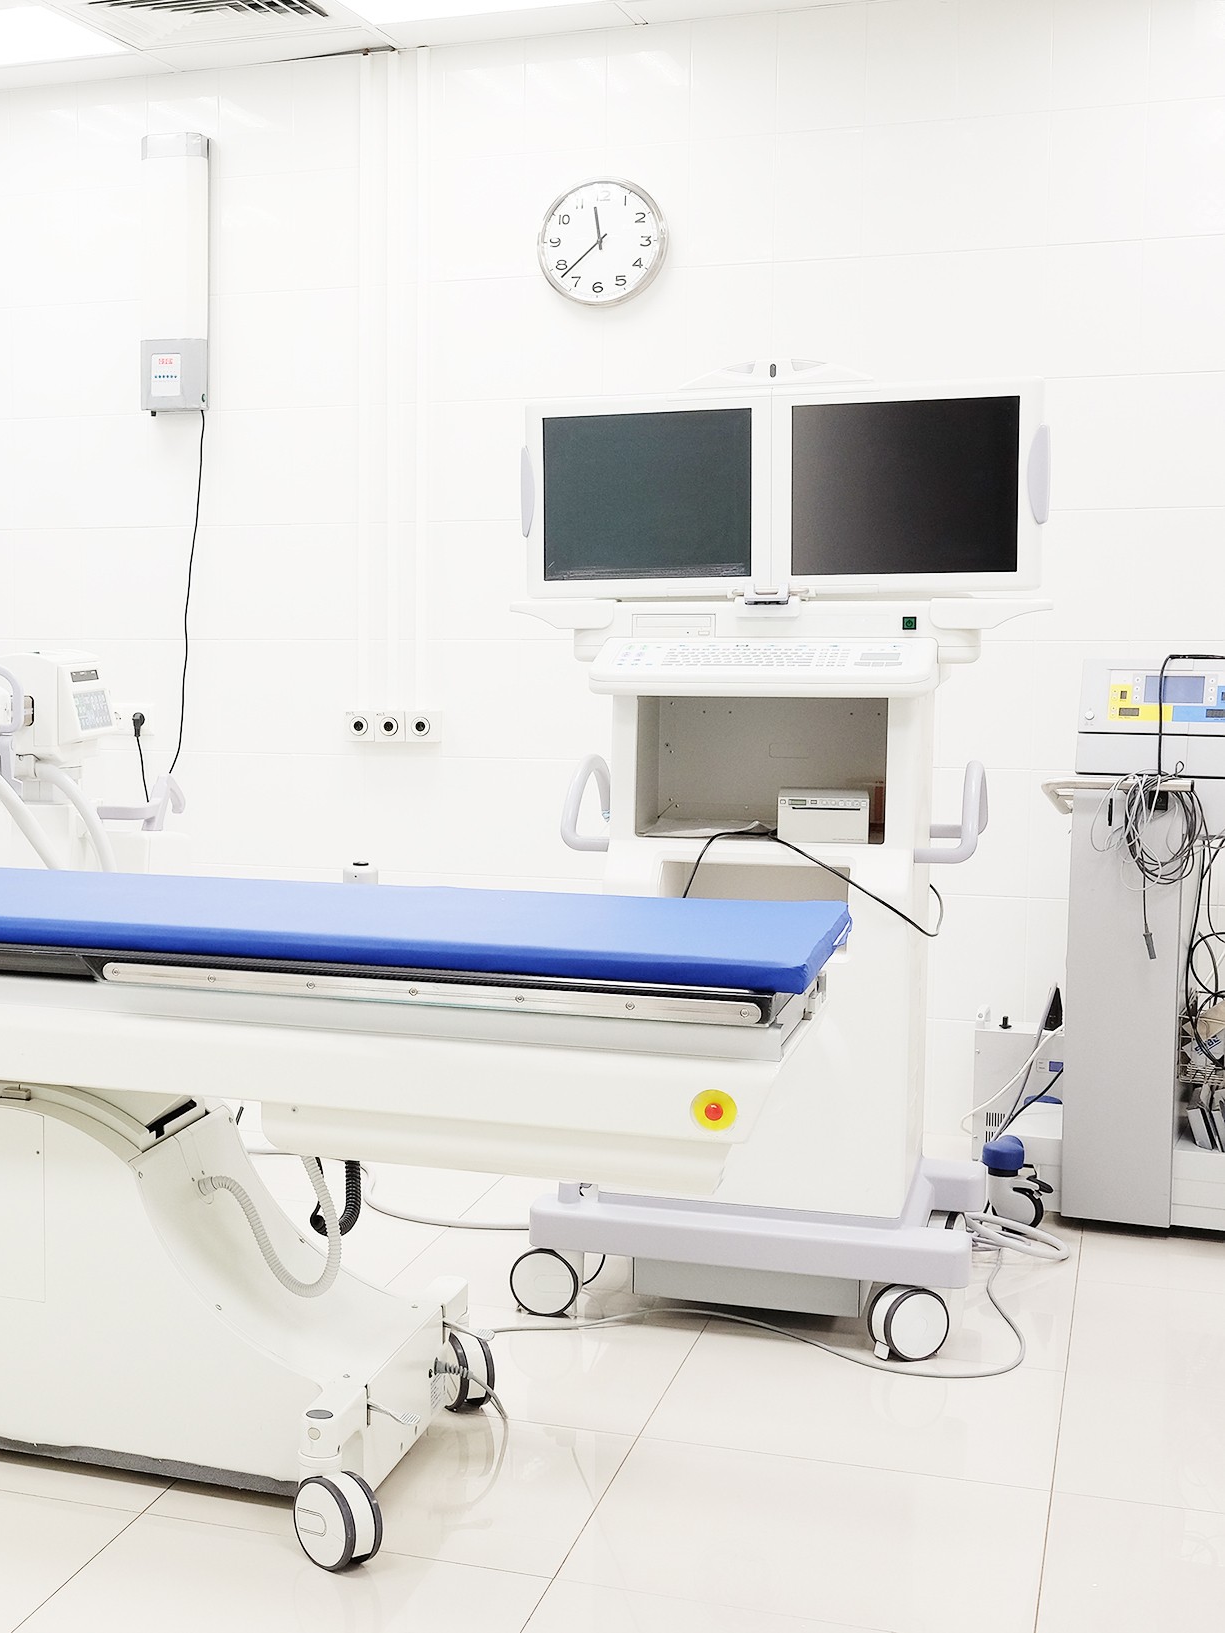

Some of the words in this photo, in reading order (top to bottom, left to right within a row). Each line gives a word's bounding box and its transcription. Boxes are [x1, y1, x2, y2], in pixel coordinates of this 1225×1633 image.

[596, 190, 611, 202] 12
[623, 195, 627, 206] 1
[558, 214, 571, 225] 10
[634, 212, 646, 223] 2
[549, 237, 562, 248] 9
[639, 235, 652, 247] 3
[555, 259, 568, 271] 8
[631, 257, 644, 269] 4
[571, 276, 582, 288] 7
[591, 281, 604, 293] 6
[615, 275, 627, 287] 5
